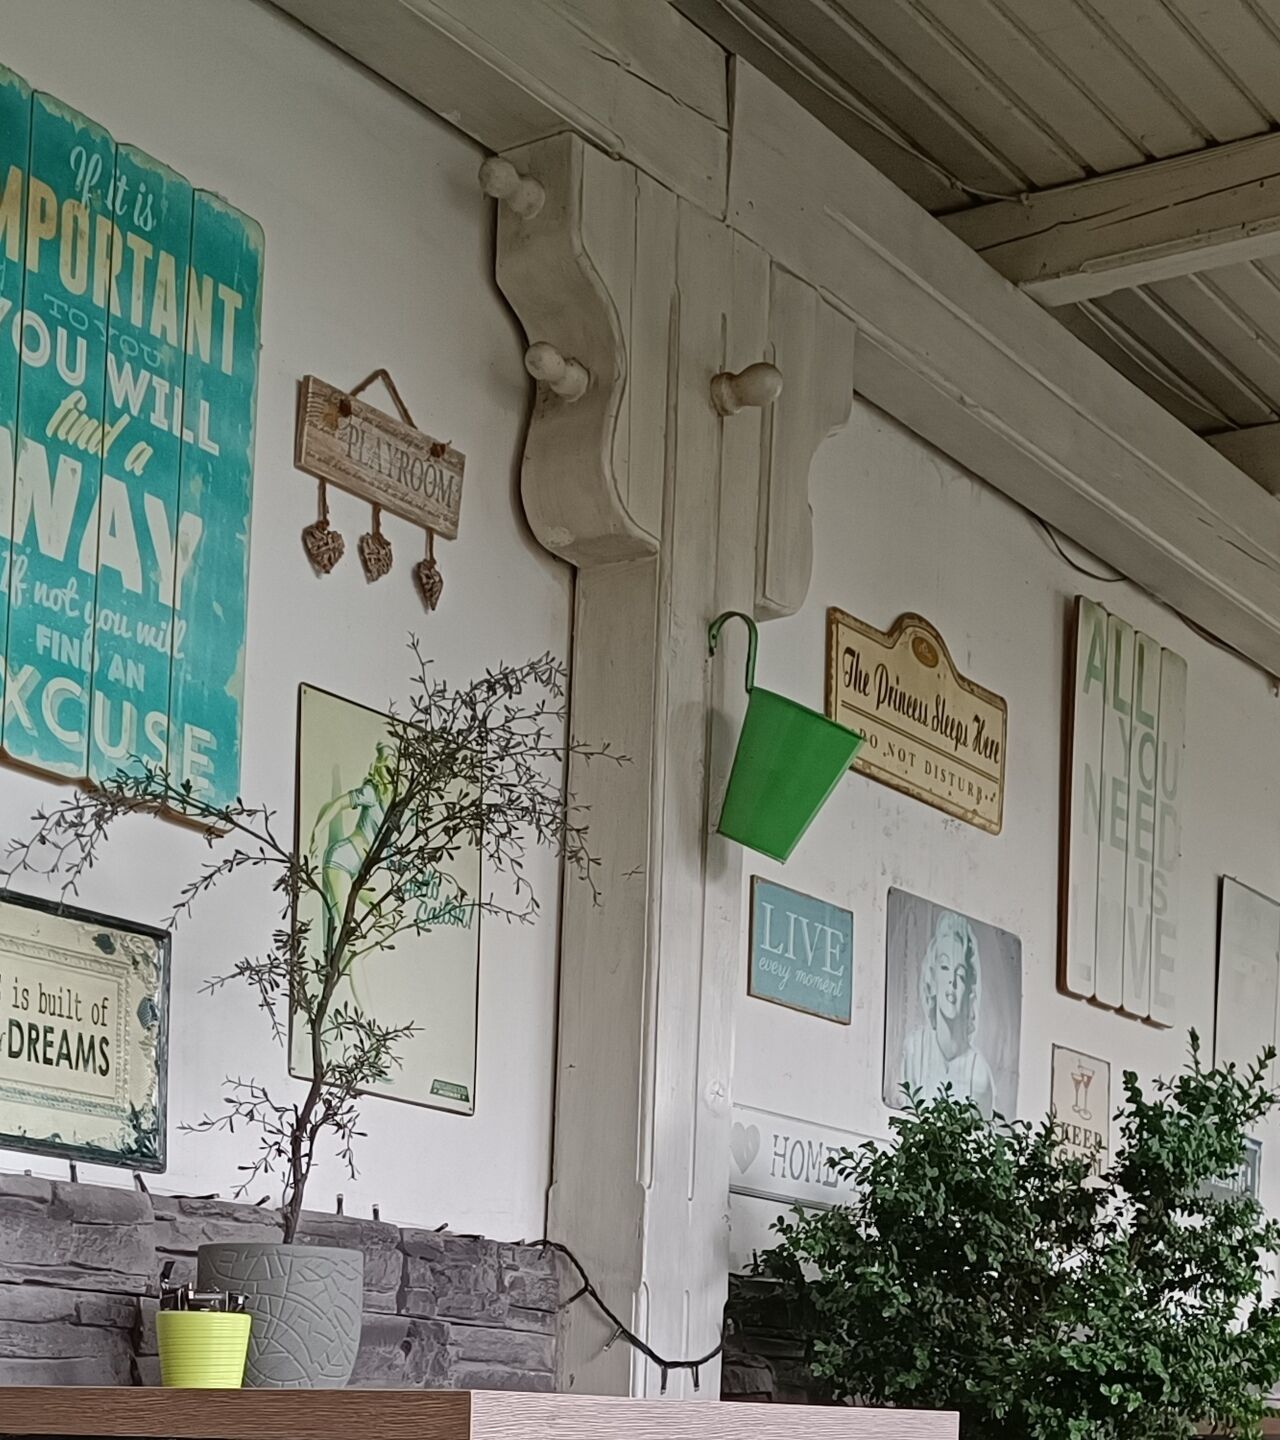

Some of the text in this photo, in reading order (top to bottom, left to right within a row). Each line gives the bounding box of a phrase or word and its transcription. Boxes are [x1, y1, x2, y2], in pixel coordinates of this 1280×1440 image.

[70, 146, 158, 232] If it is
[43, 293, 161, 368] TO YOU
[45, 390, 154, 476] find a
[107, 352, 220, 457] WILL
[345, 420, 456, 509] PLAYROOM
[34, 577, 80, 618] not
[83, 600, 133, 658] you
[136, 615, 187, 660] will
[36, 623, 145, 693] FIND AN
[842, 645, 1001, 765] The Princess Sleeps Here
[1082, 620, 1155, 731] ALL
[859, 727, 983, 806] DO NOT DISTURB
[1118, 716, 1179, 802] YOU
[1082, 762, 1181, 874] NEED
[1137, 863, 1169, 917] IS
[759, 954, 843, 998] every moment
[760, 902, 845, 978] LIVE
[11, 976, 30, 1010] is
[38, 982, 84, 1023] built
[90, 998, 109, 1027] of
[7, 1017, 111, 1077] DREAMS
[770, 1134, 841, 1189] HOME
